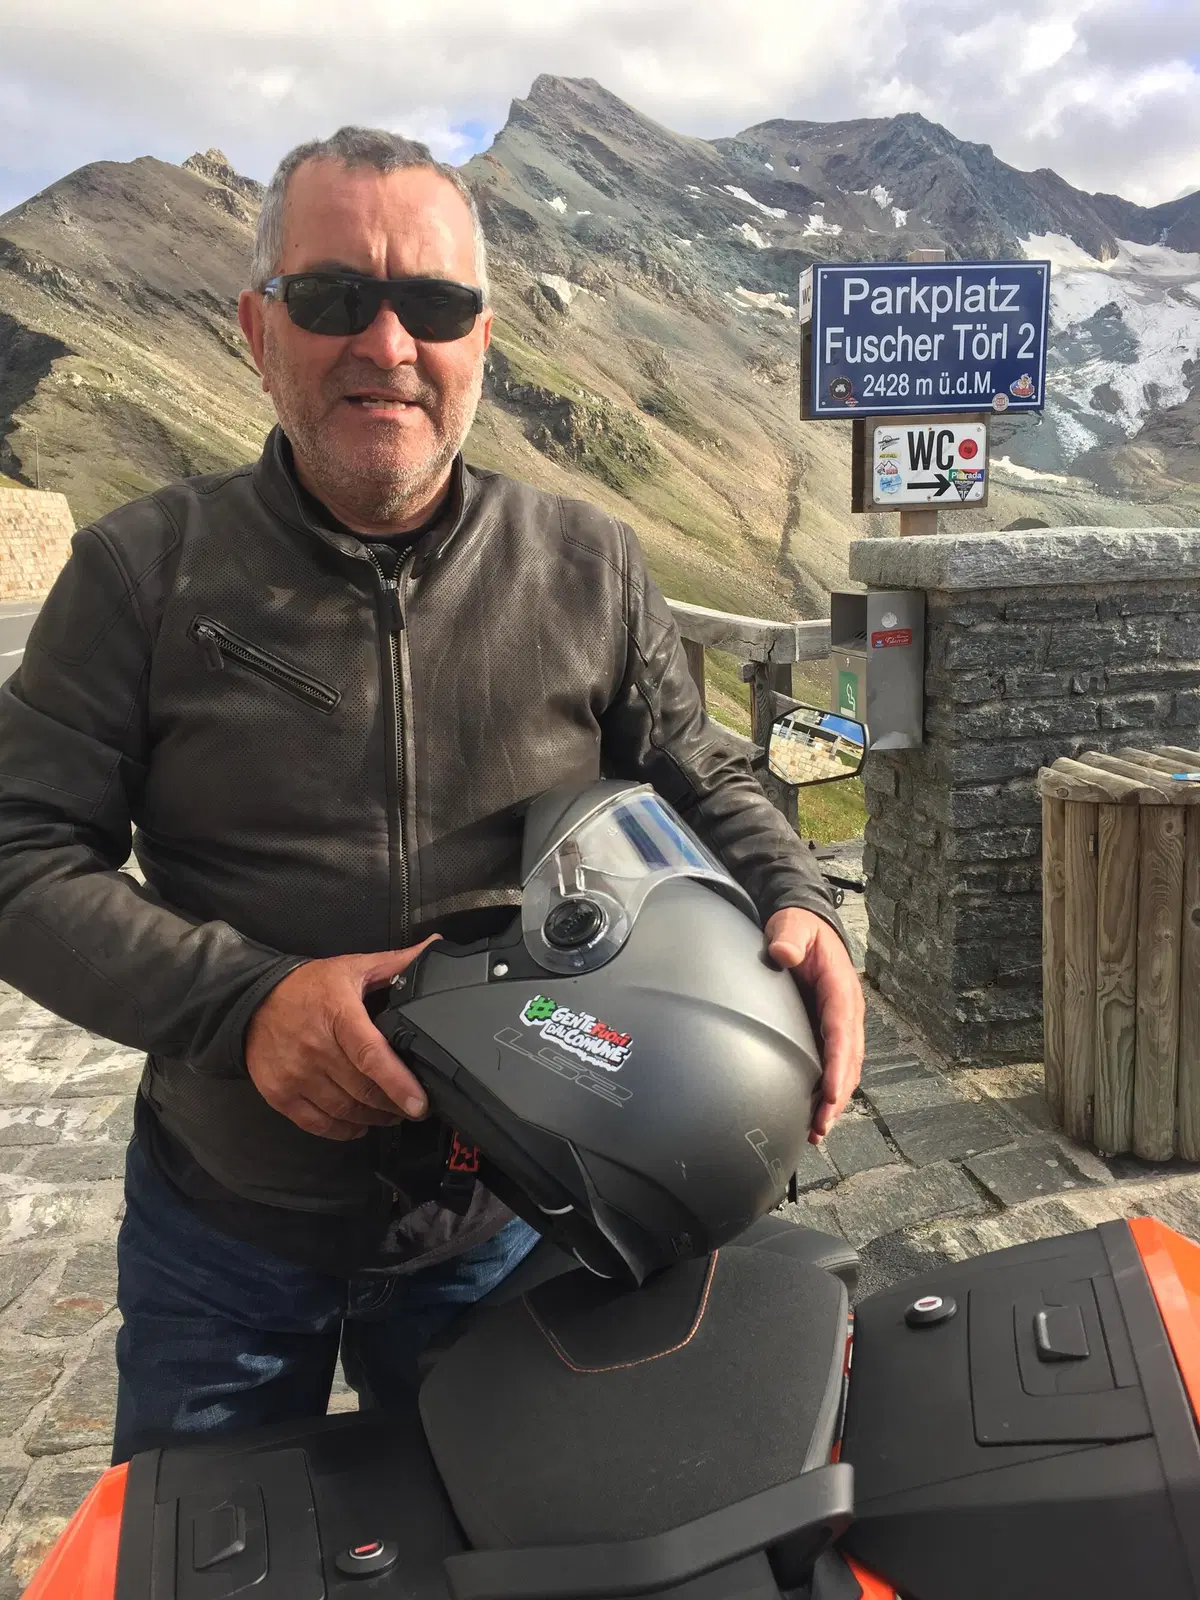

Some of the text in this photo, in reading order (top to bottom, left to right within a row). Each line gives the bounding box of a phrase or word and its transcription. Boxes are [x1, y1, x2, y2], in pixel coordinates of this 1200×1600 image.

[843, 275, 1020, 322] Parkplatz
[825, 322, 1036, 364] Fuscher Törl 2
[863, 371, 996, 397] 2428 m ü.d.M.
[907, 429, 955, 471] WC
